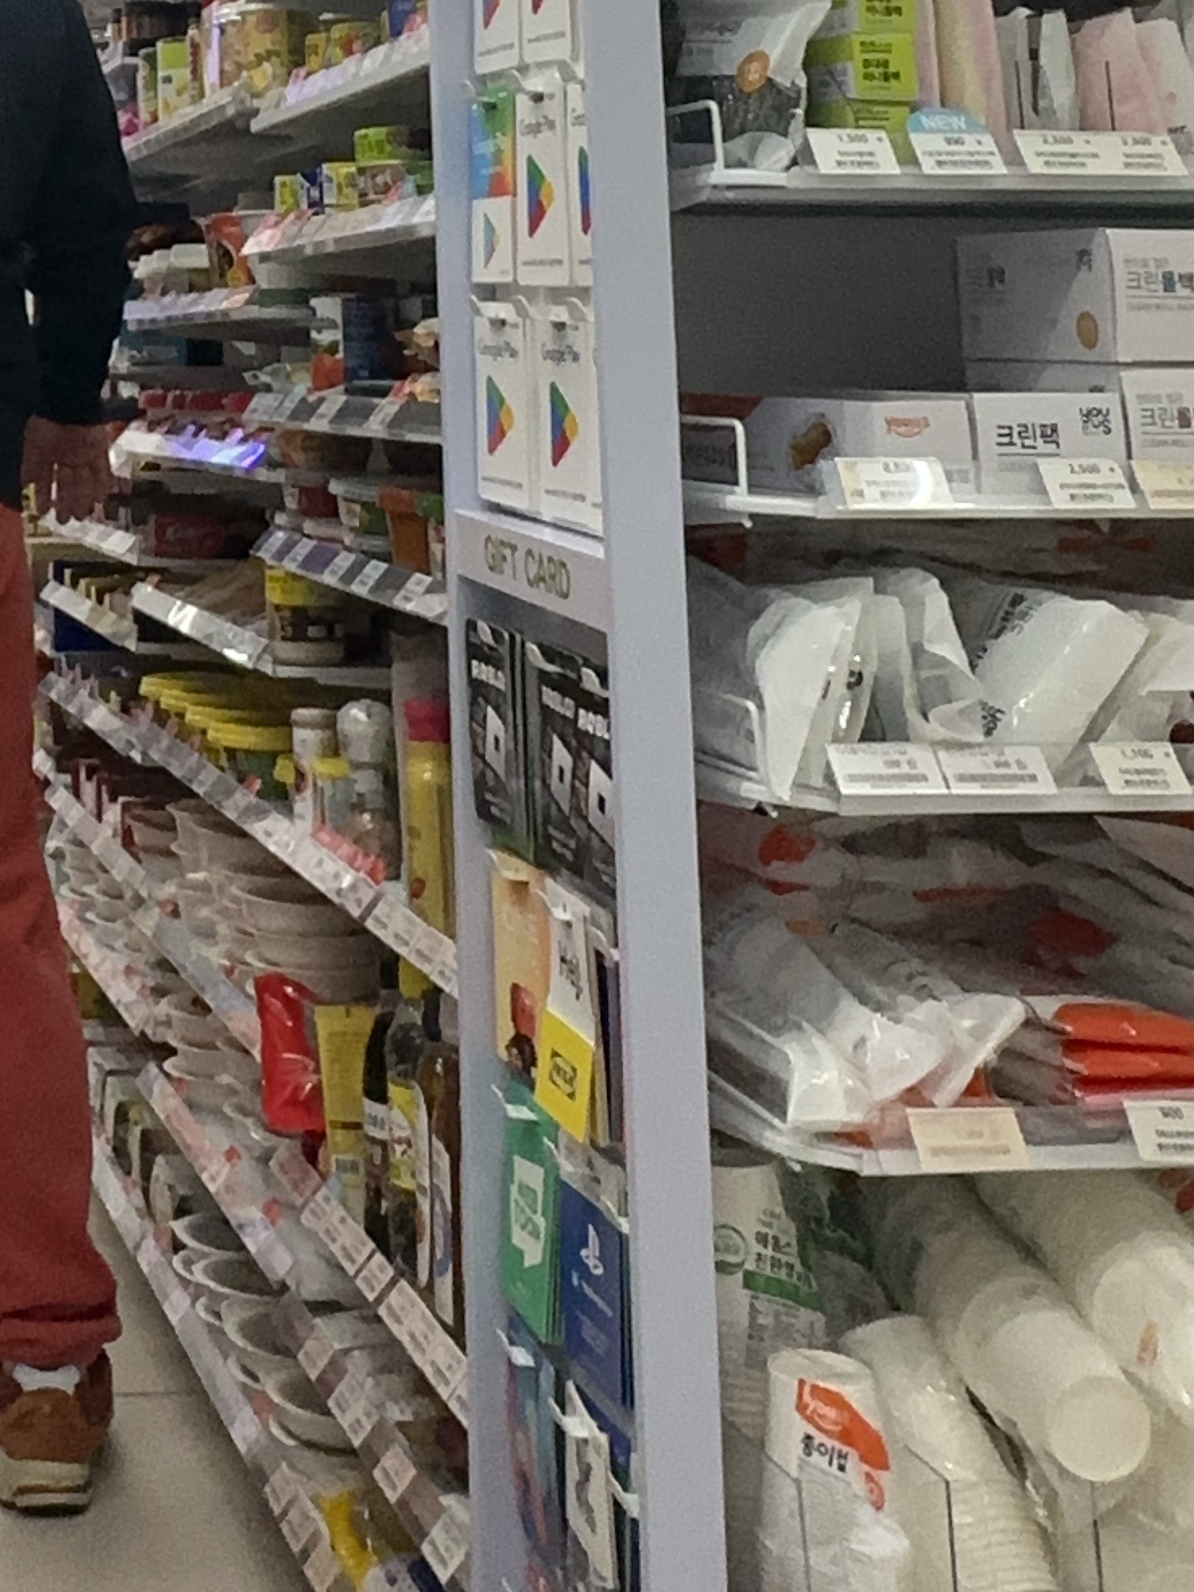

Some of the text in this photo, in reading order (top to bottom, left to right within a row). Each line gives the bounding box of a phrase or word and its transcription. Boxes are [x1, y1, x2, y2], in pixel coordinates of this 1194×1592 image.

[919, 115, 969, 130] NEW
[484, 534, 572, 601] GIFT CARD
[800, 1431, 849, 1473] 종이컵
